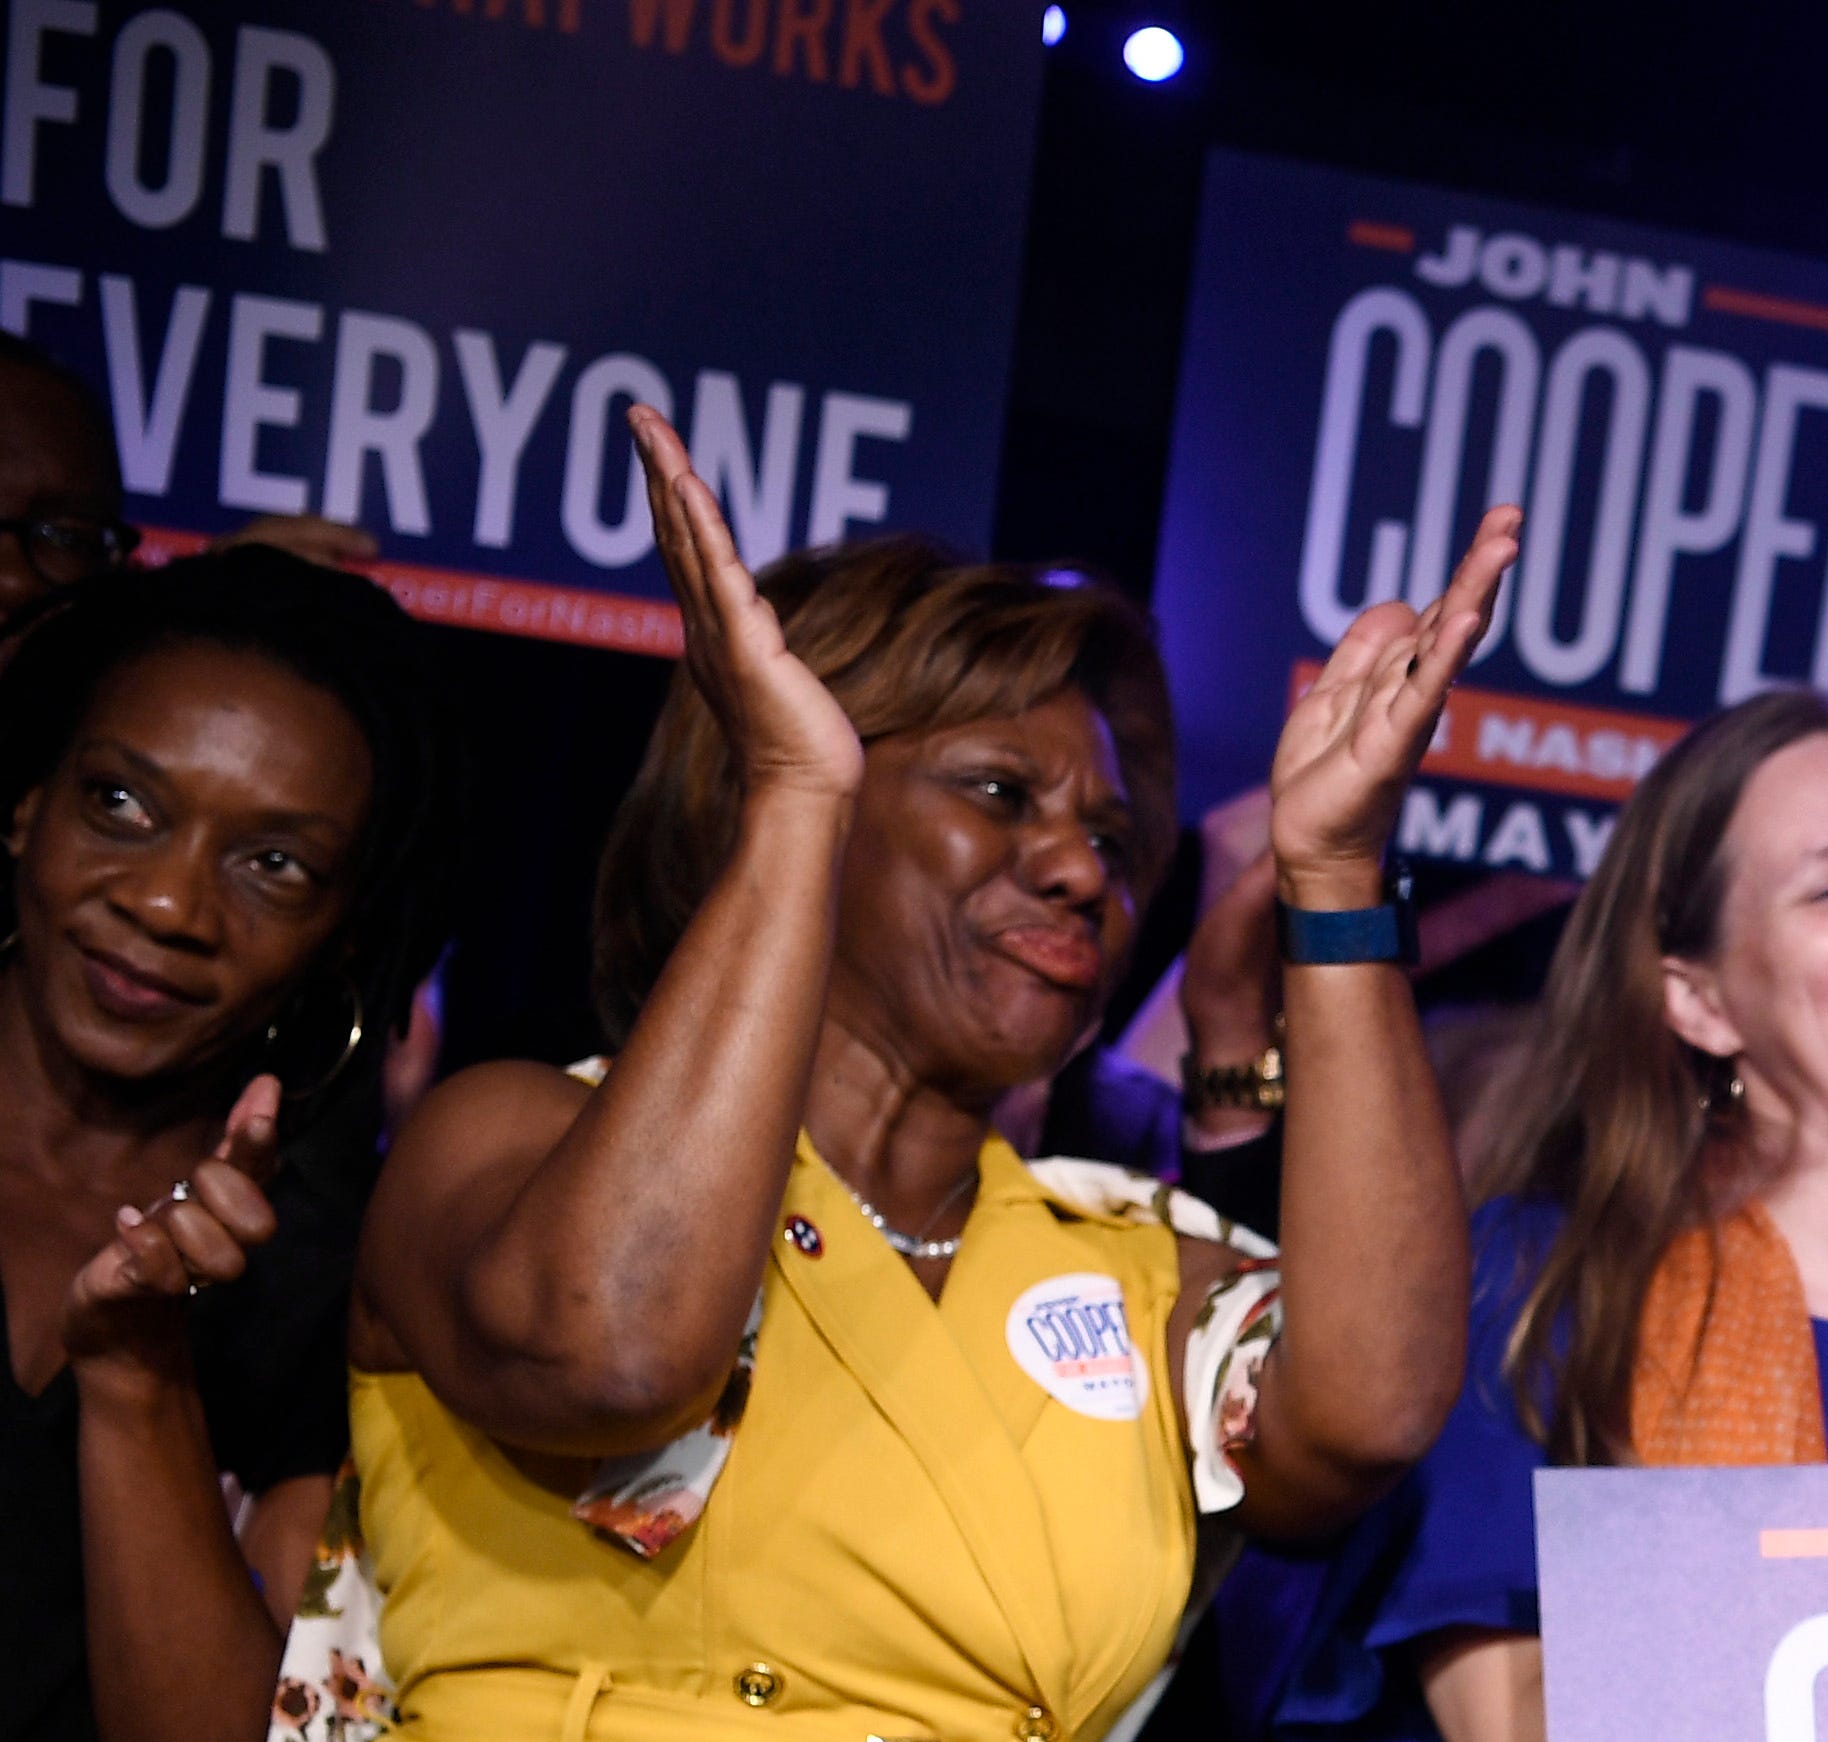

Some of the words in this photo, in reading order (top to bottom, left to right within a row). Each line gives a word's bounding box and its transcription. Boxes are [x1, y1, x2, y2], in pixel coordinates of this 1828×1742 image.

[3, 3, 336, 253] FOR
[1415, 226, 1695, 328] JOHN
[1402, 786, 1614, 878] MAY
[1025, 1300, 1131, 1363] COOPE
